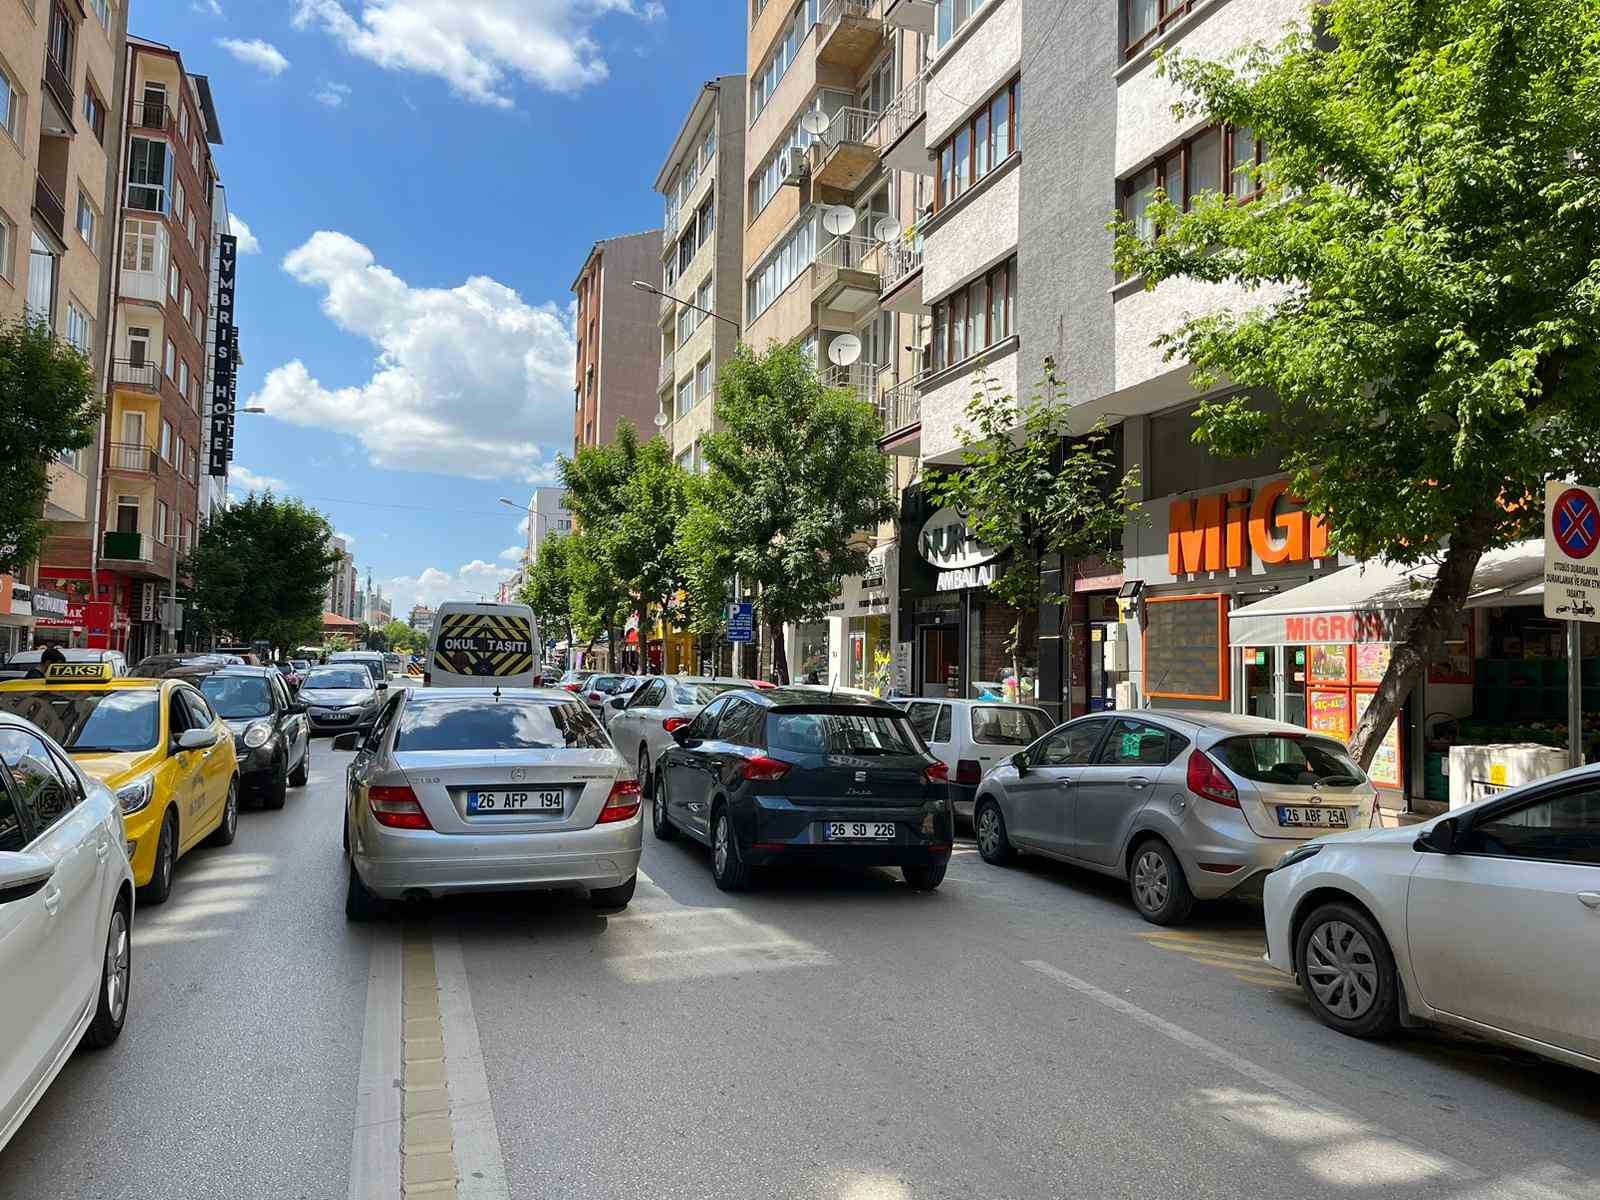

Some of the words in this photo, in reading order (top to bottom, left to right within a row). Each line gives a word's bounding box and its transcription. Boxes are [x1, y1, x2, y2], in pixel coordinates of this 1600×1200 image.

[218, 242, 234, 358] TYMBRIS
[213, 386, 228, 468] HOTEL
[444, 638, 478, 650] OKUL
[478, 792, 494, 808] 26
[503, 792, 528, 808] AFP
[539, 791, 560, 808] 194
[1286, 808, 1299, 822] 26
[1304, 809, 1321, 823] ABF
[1327, 811, 1345, 823] 254
[831, 823, 845, 836] 26
[852, 823, 867, 836] SD
[874, 824, 894, 836] 226
